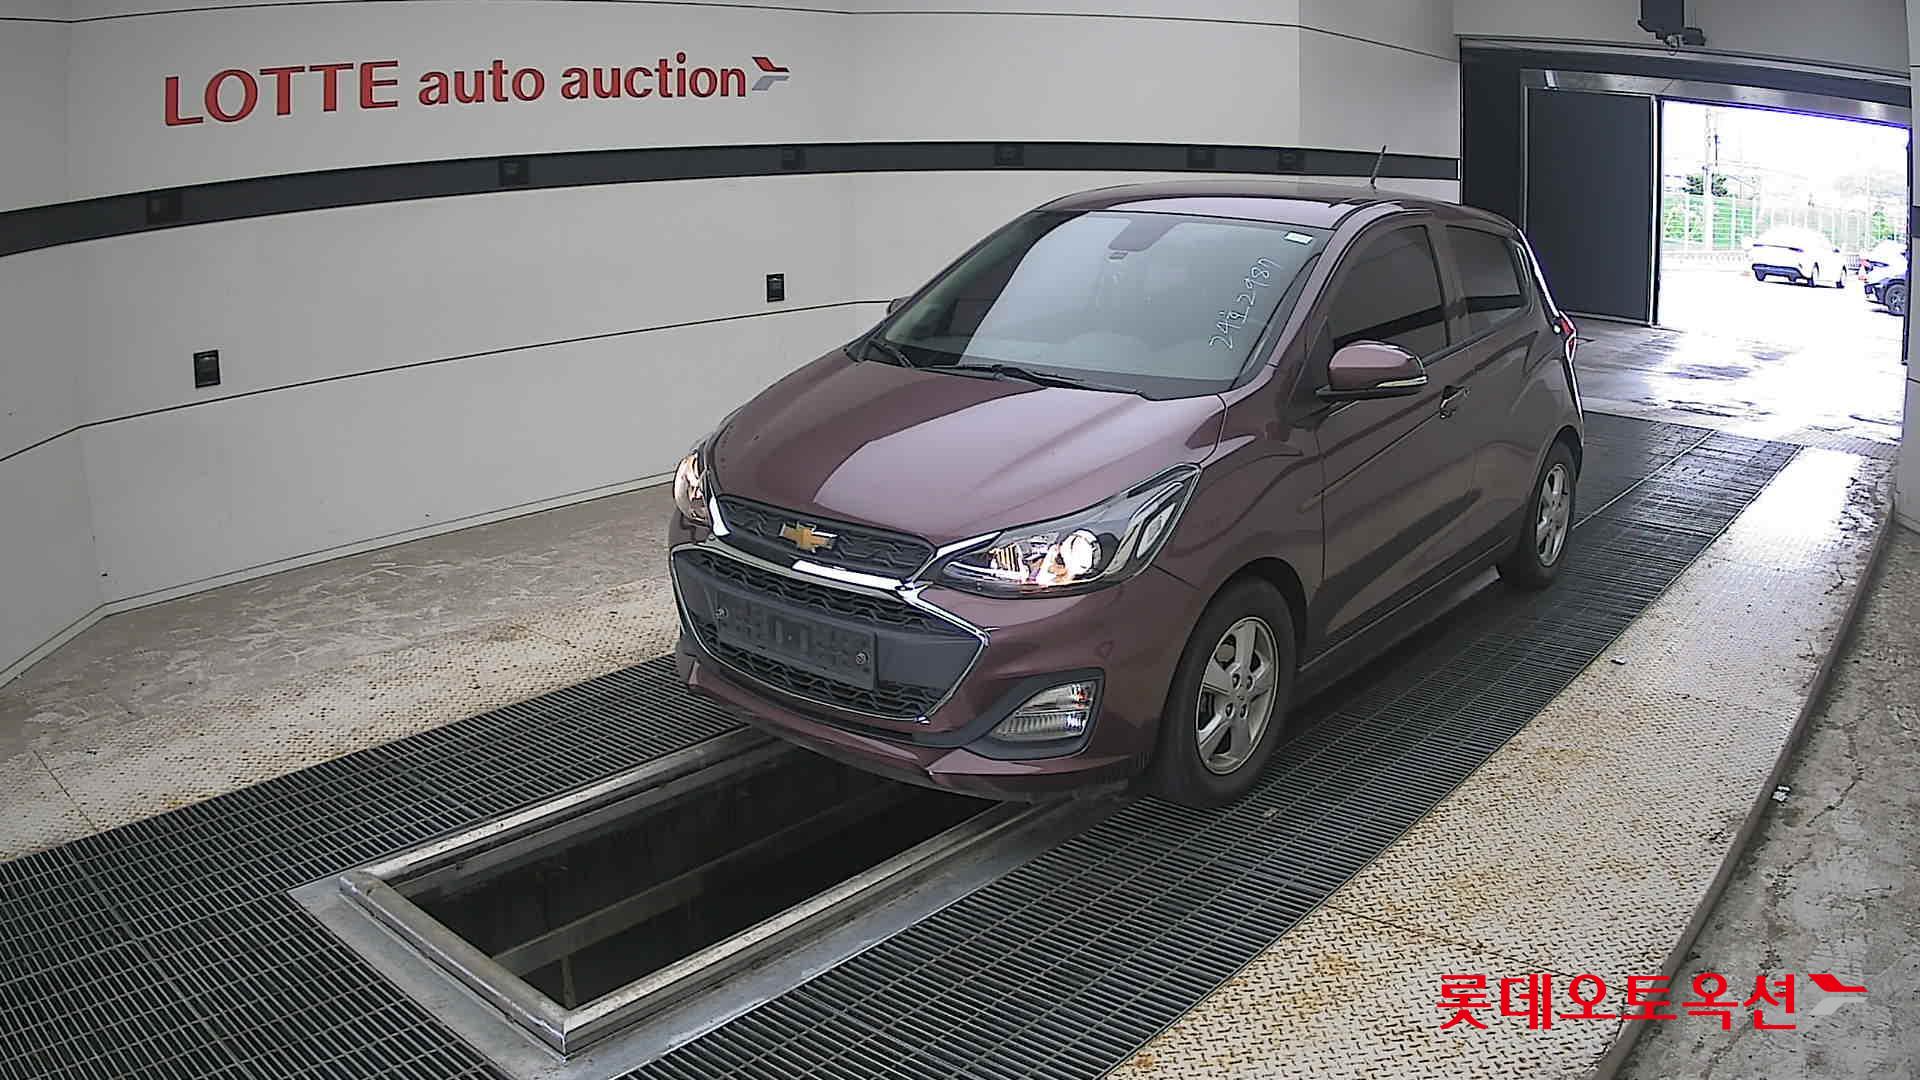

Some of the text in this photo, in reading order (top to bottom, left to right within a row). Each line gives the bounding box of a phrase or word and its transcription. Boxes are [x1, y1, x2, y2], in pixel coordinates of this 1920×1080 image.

[164, 52, 747, 126] LOTTE auto auction
